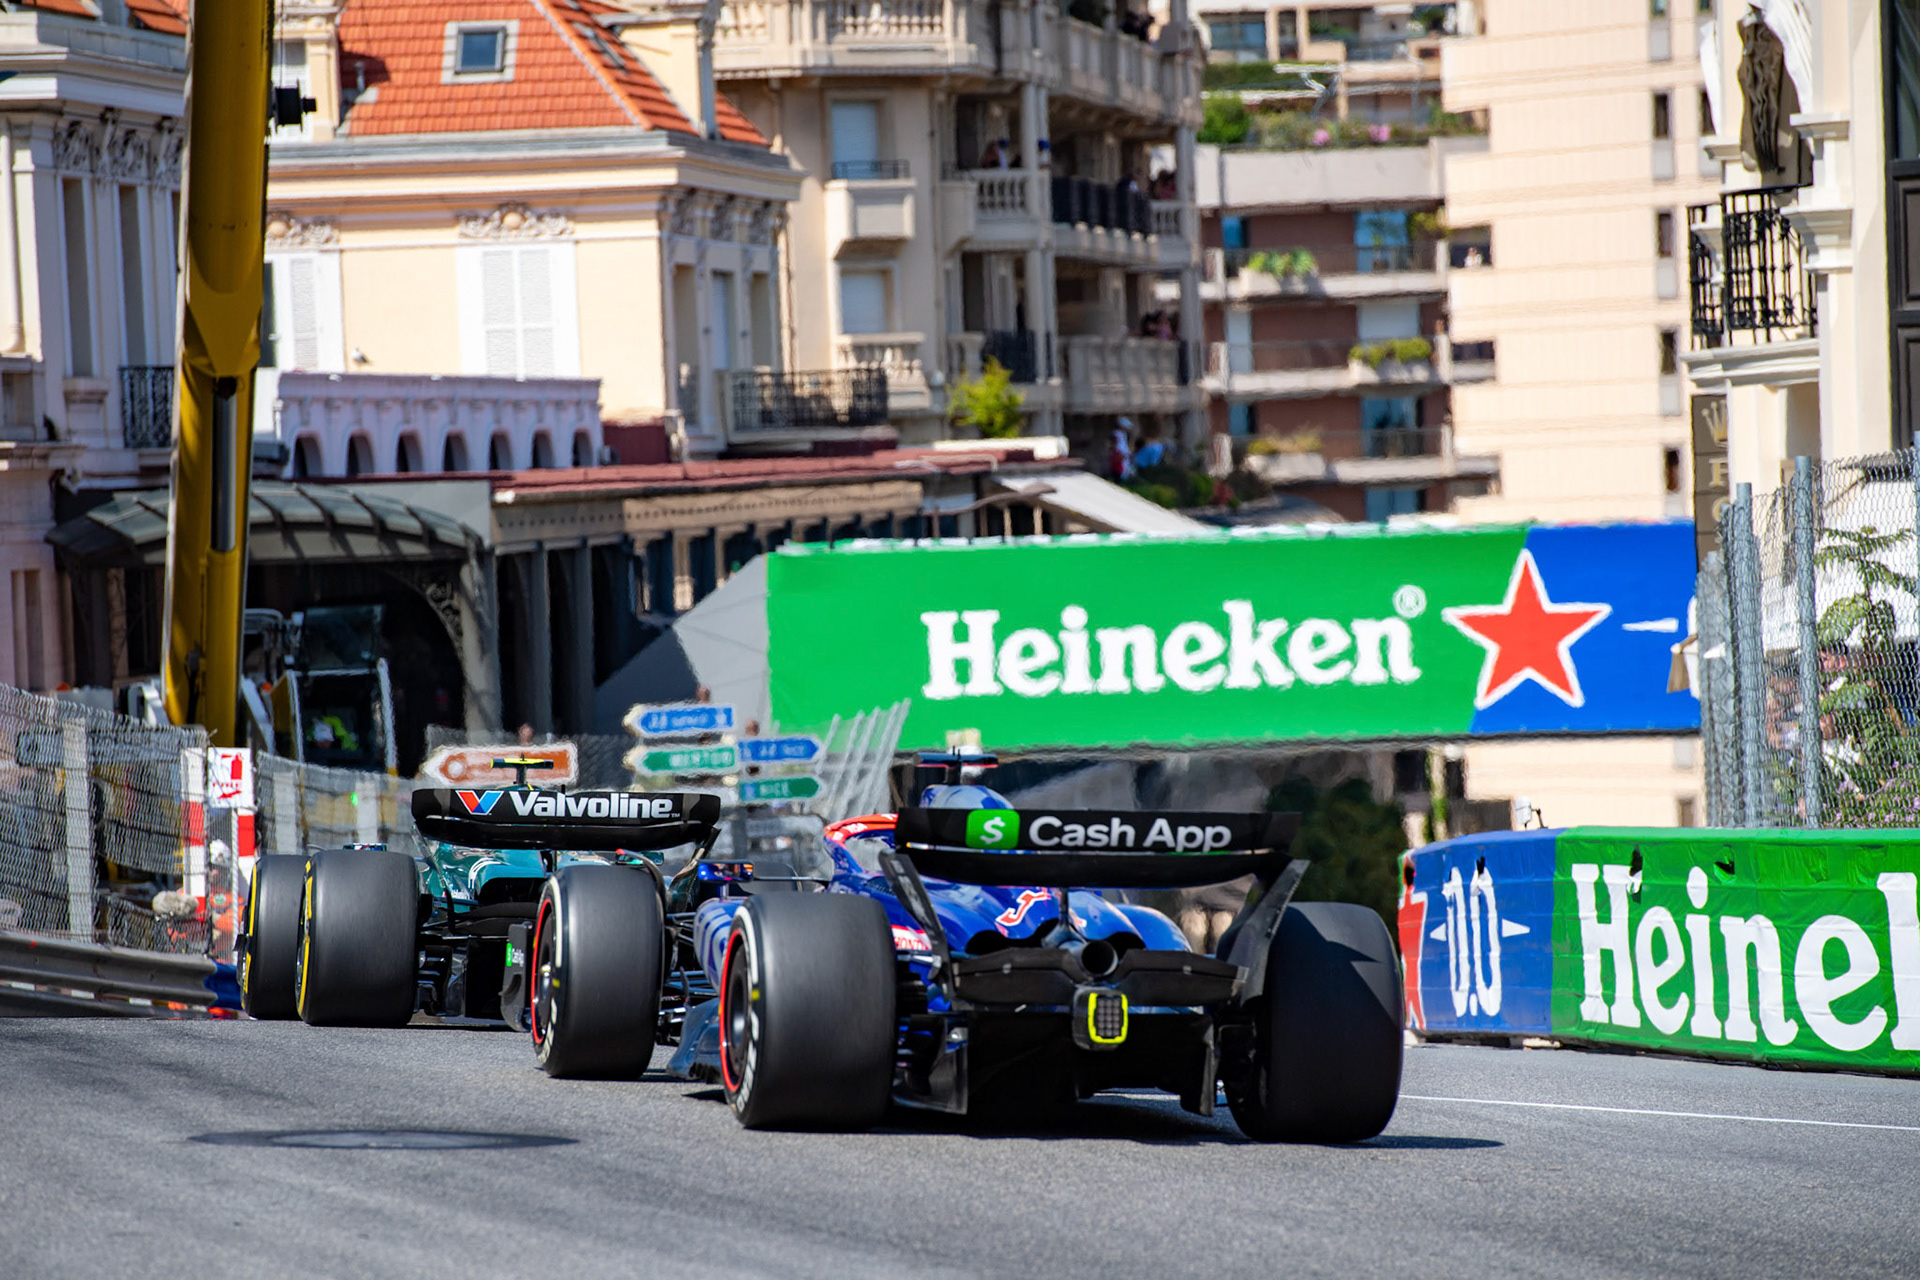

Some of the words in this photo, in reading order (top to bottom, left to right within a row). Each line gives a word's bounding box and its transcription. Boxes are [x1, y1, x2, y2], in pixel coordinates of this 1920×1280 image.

[921, 600, 1422, 700] Heineken
[509, 790, 673, 818] Valvoline
[1029, 815, 1135, 848] Cash
[1144, 816, 1233, 854] App
